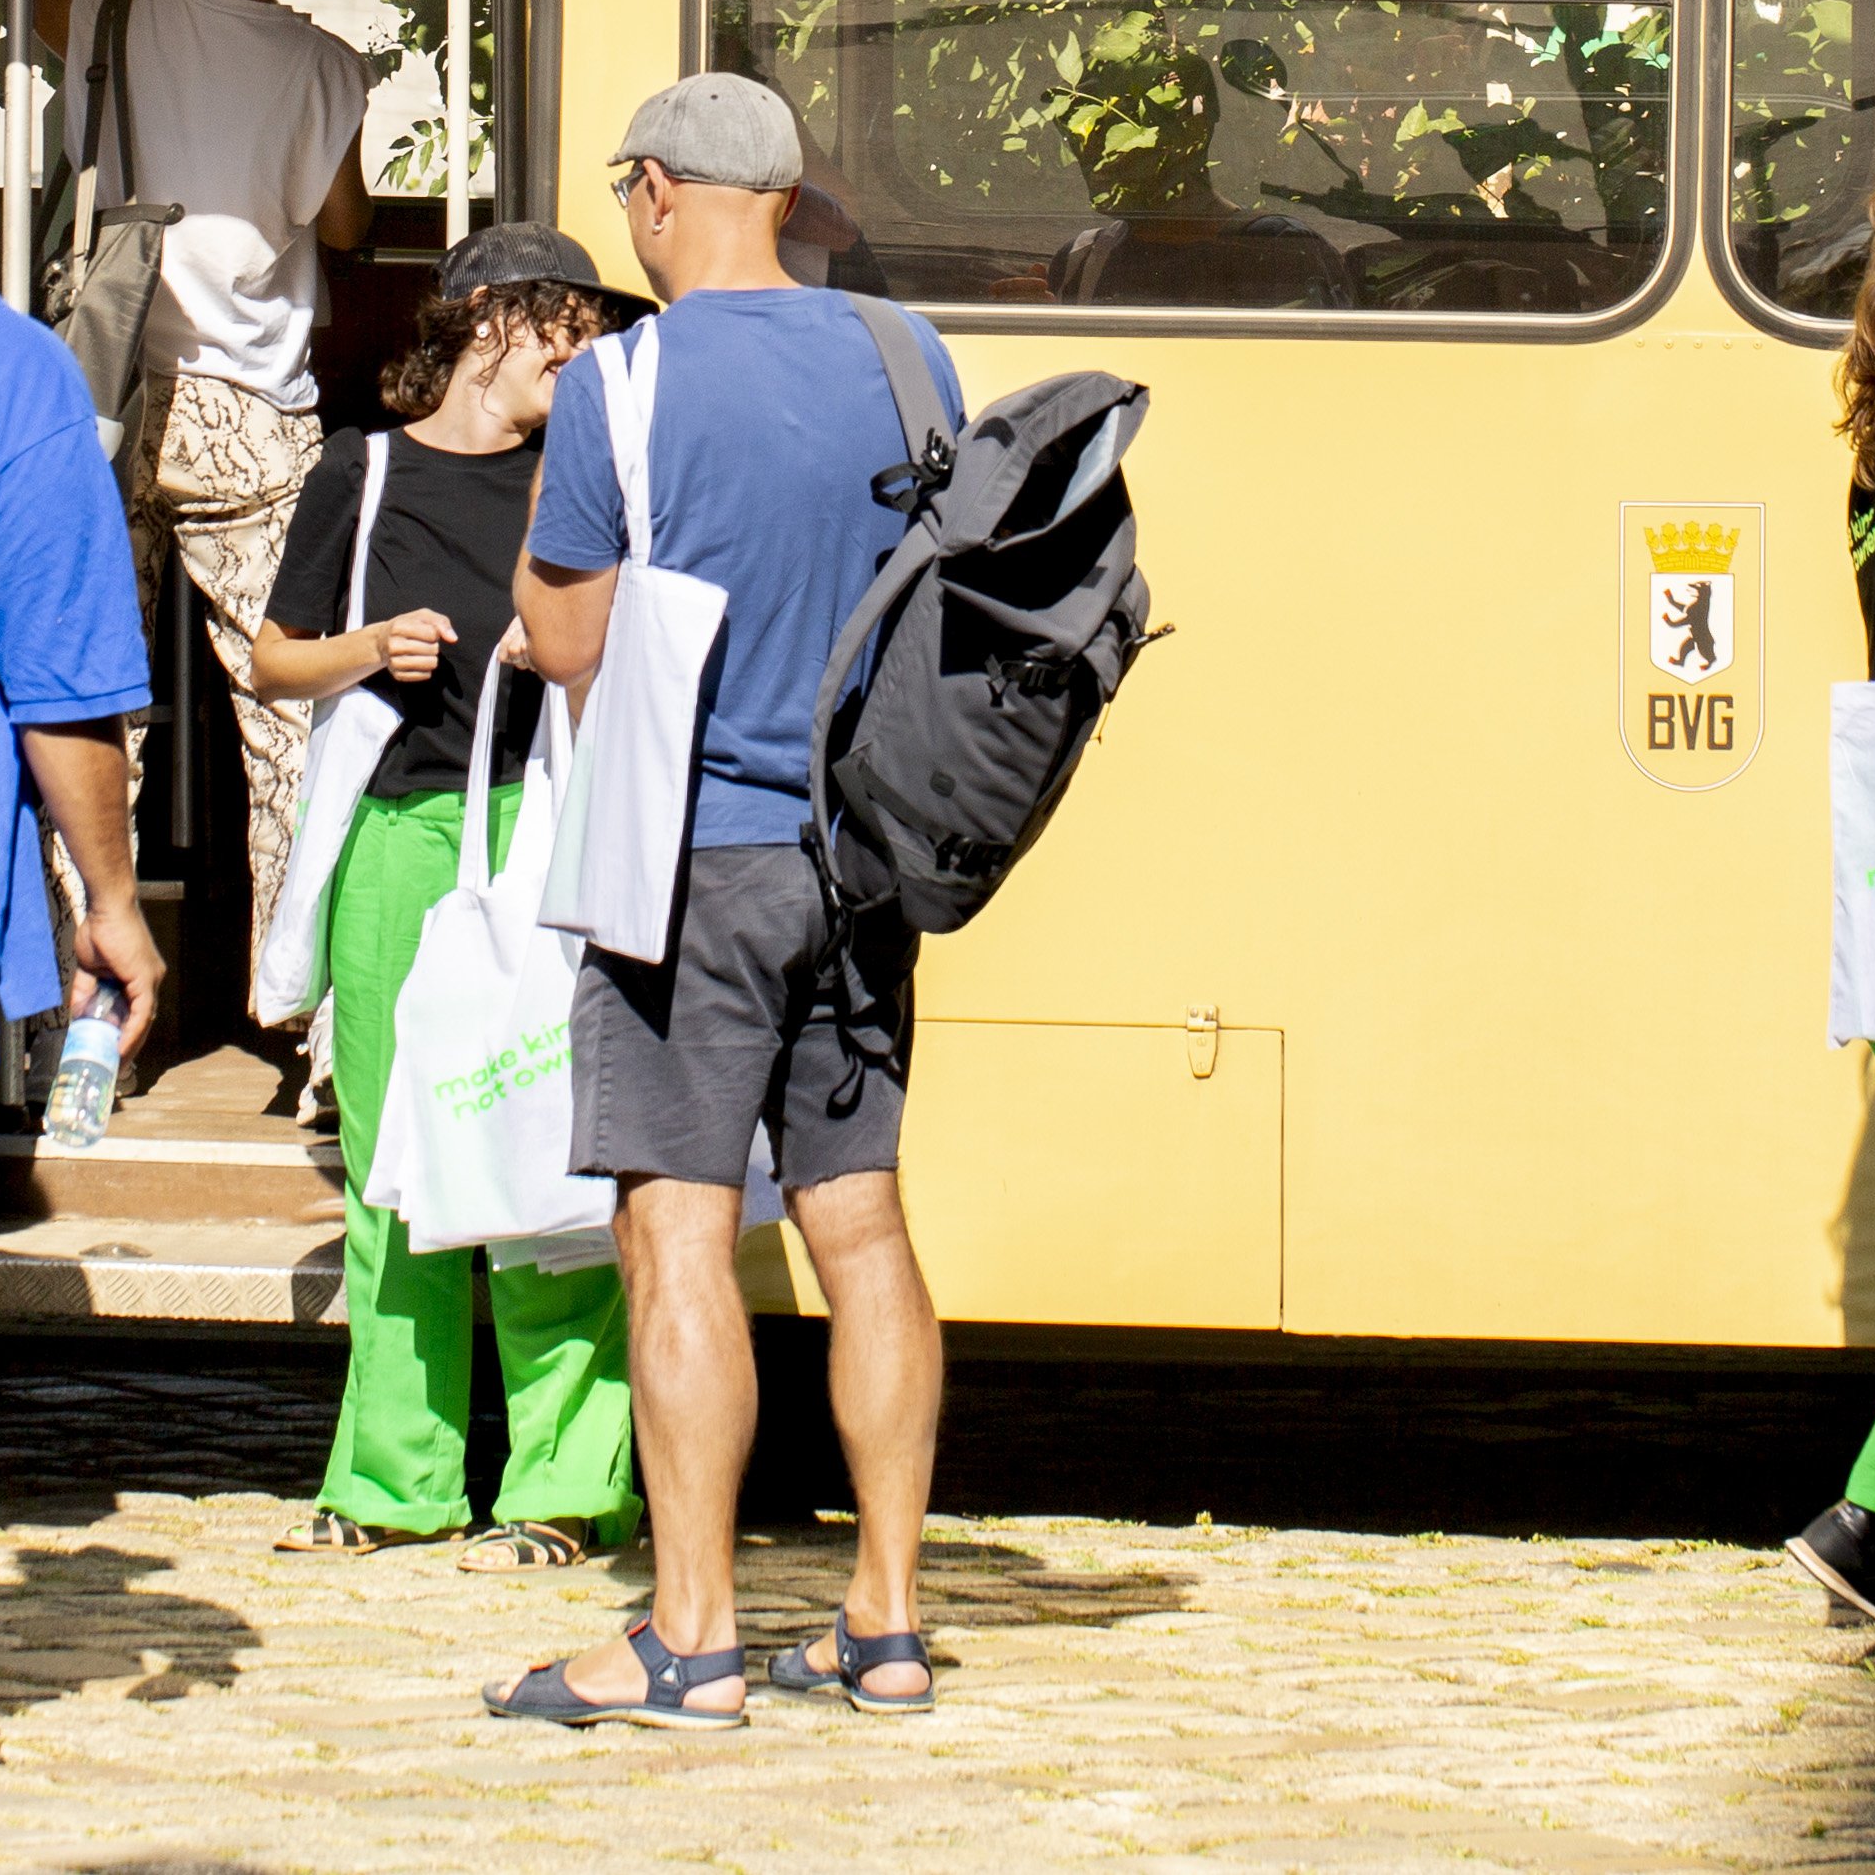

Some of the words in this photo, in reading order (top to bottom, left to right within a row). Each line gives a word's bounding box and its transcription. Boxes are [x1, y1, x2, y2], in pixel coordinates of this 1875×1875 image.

[1648, 694, 1734, 751] BVG
[433, 1048, 518, 1100] make
[452, 1078, 507, 1120] not
